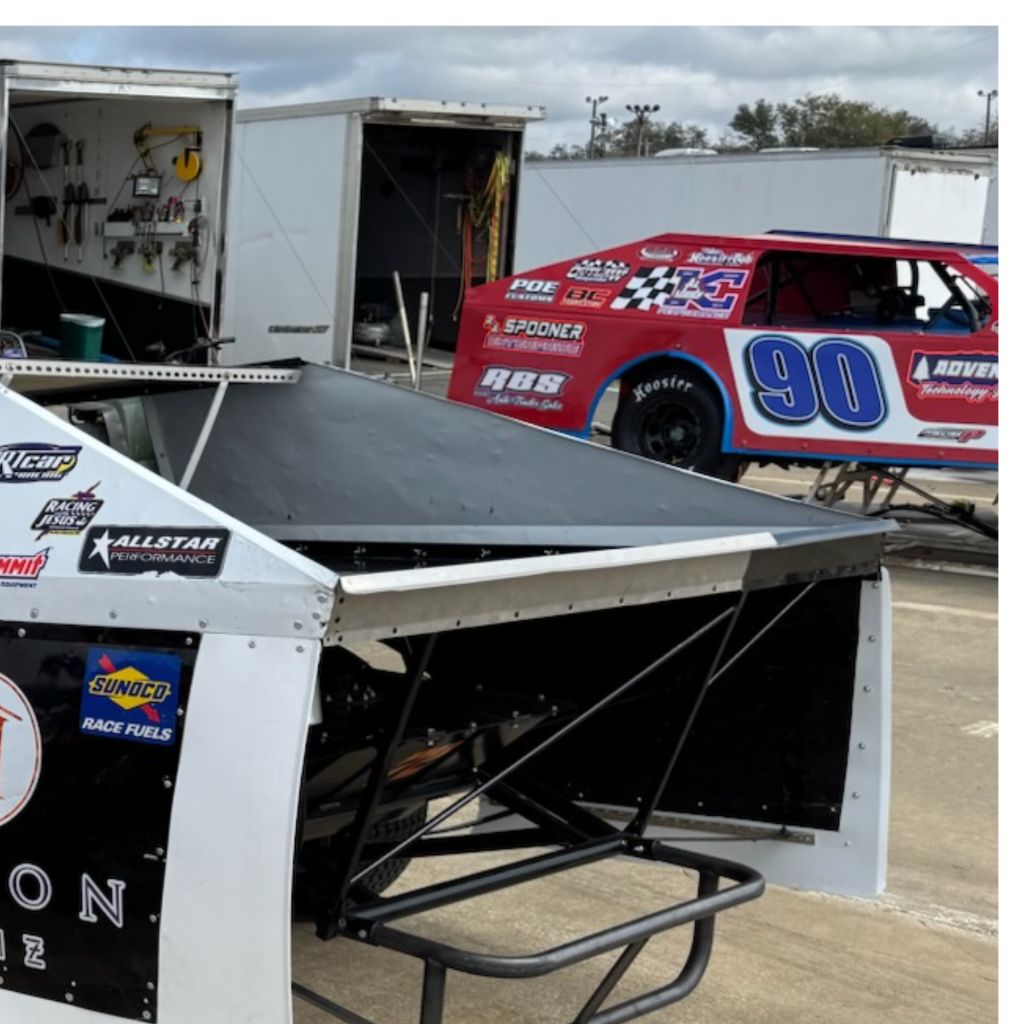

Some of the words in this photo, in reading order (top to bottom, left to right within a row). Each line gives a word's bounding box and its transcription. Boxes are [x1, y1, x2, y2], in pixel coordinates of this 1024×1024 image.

[509, 279, 560, 293] POE
[504, 319, 584, 339] SPOONER
[479, 367, 567, 394] RBS
[747, 333, 887, 428] 90
[112, 534, 222, 551] ALLSTAR
[110, 551, 216, 565] PERFORMANCE
[91, 676, 168, 702] SUNOCO
[81, 717, 123, 734] RACE
[124, 723, 173, 741] FUELS
